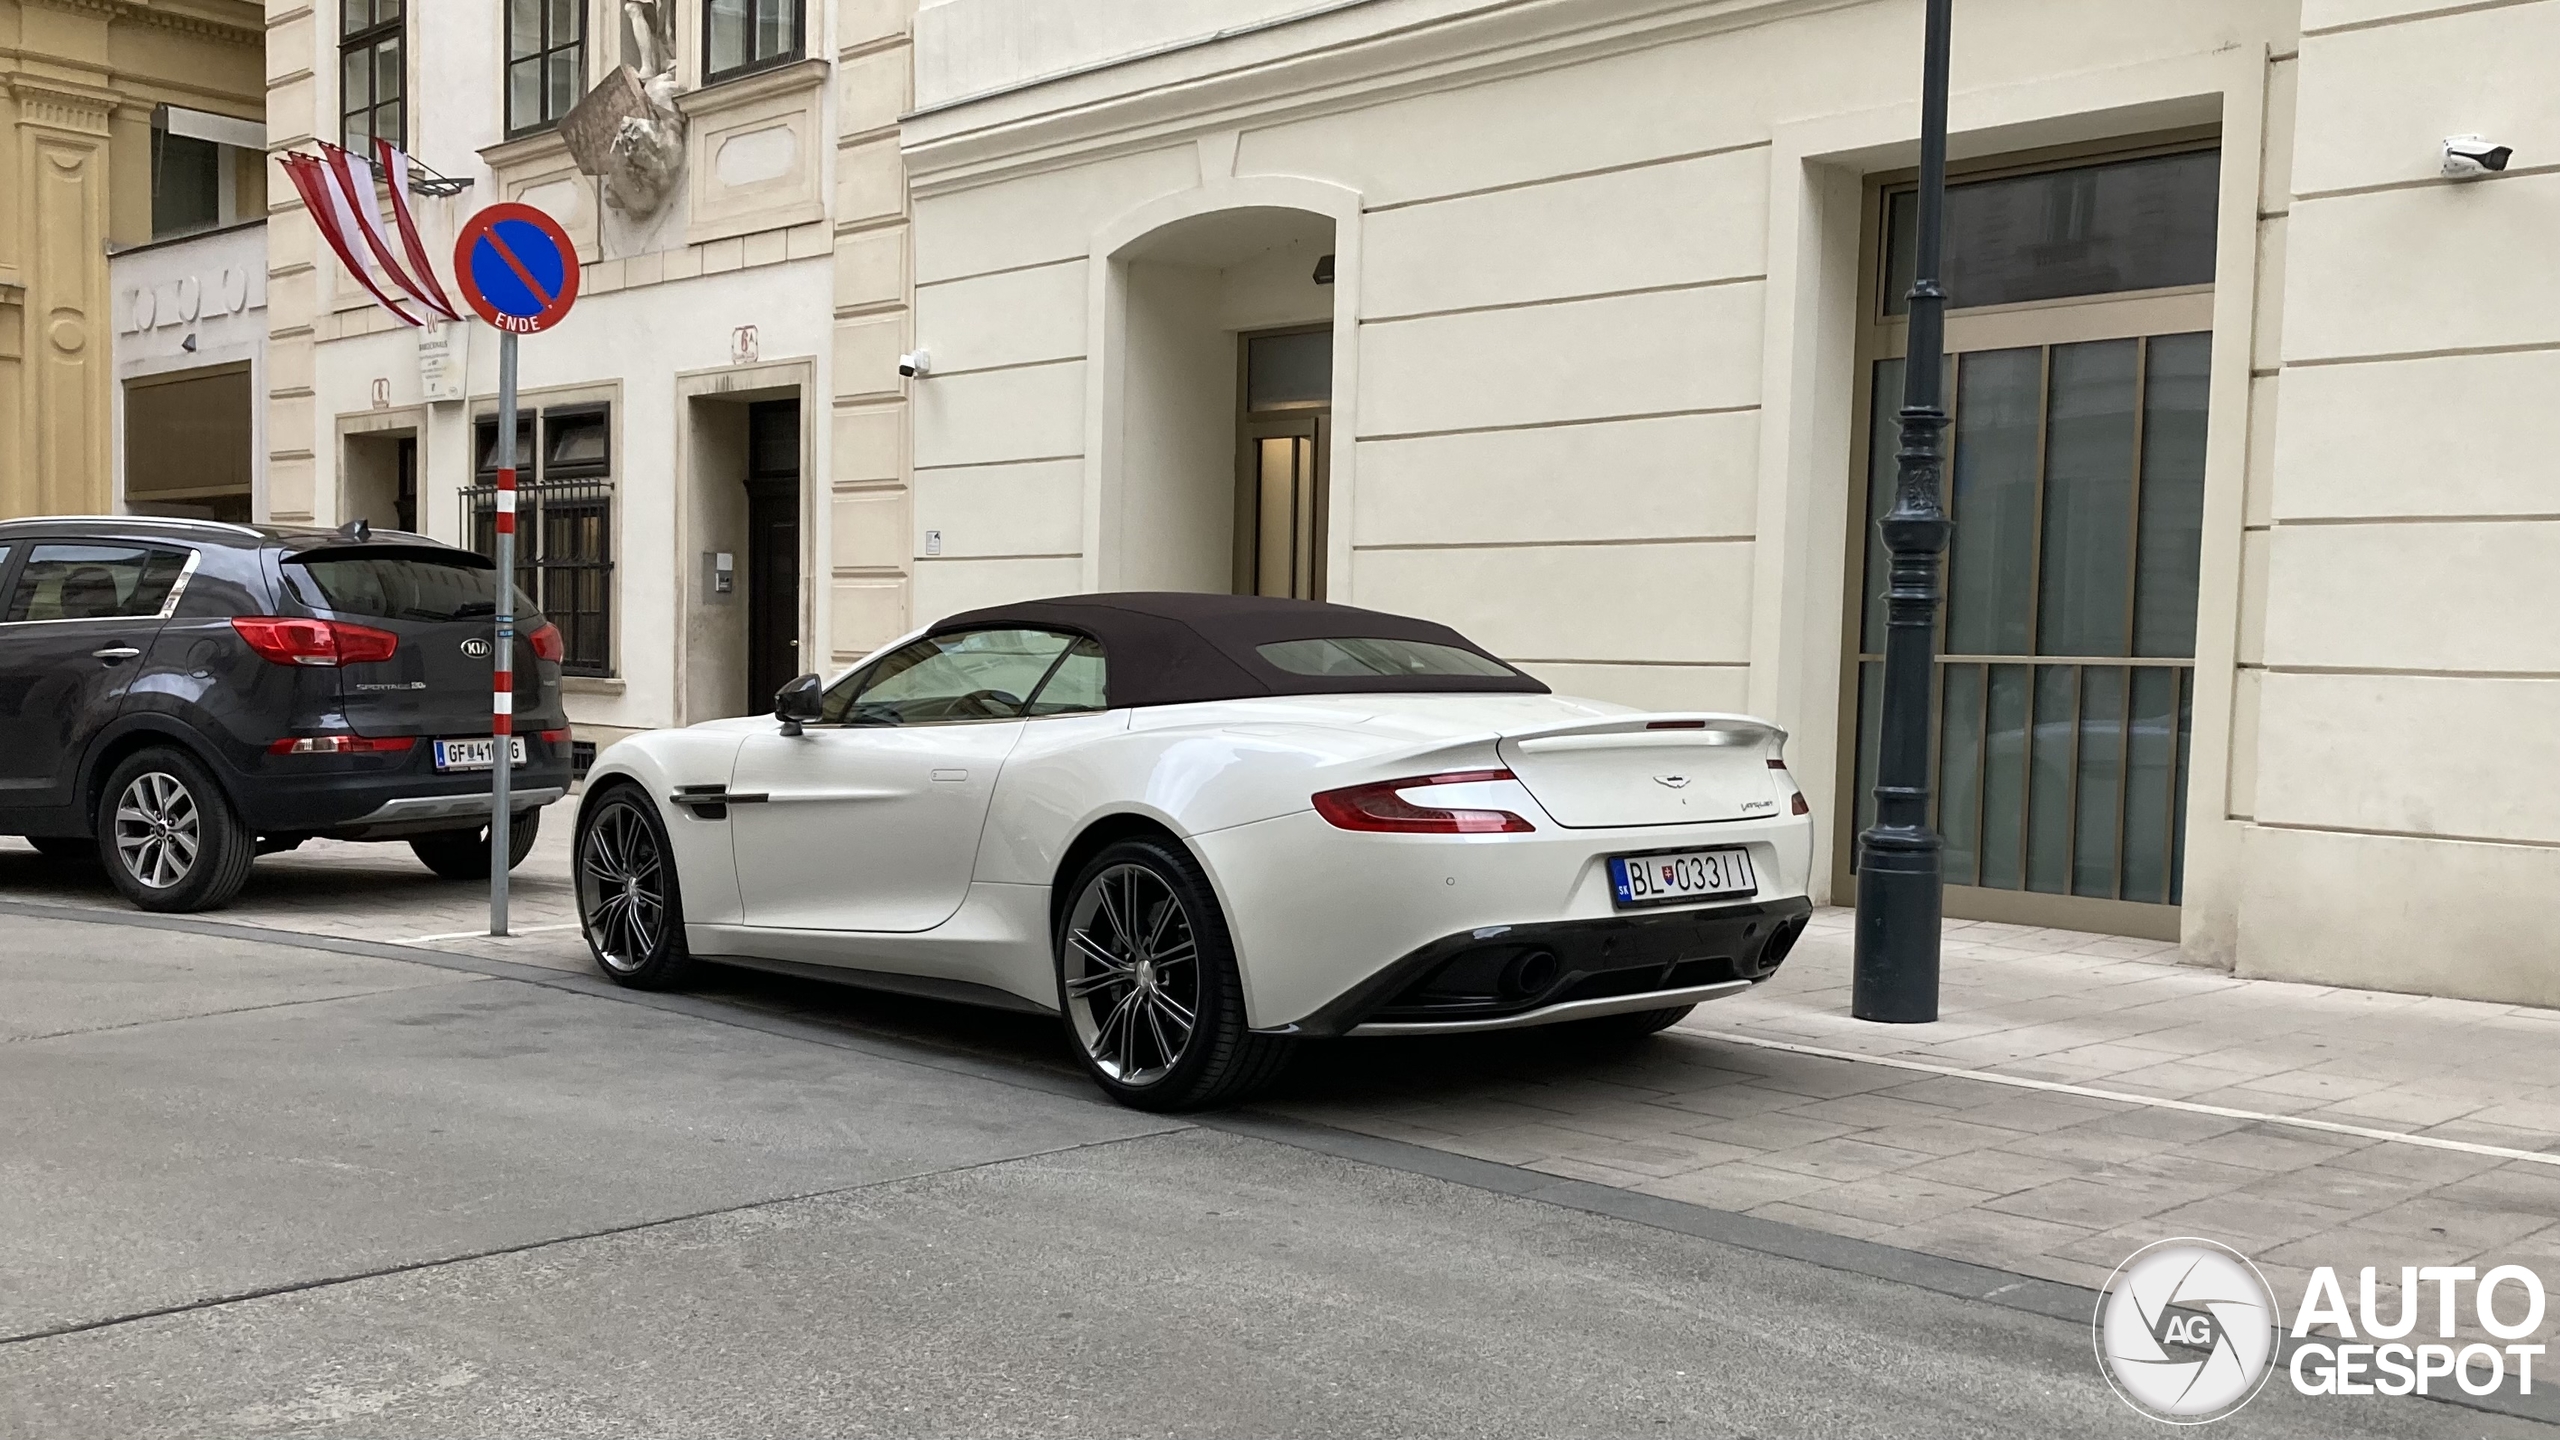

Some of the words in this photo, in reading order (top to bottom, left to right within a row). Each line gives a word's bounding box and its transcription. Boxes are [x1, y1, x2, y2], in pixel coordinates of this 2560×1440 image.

[495, 312, 540, 331] ENDE
[467, 642, 488, 654] KIA
[449, 744, 466, 762] GF
[1629, 860, 1665, 895] BL
[1618, 885, 1629, 895] SK
